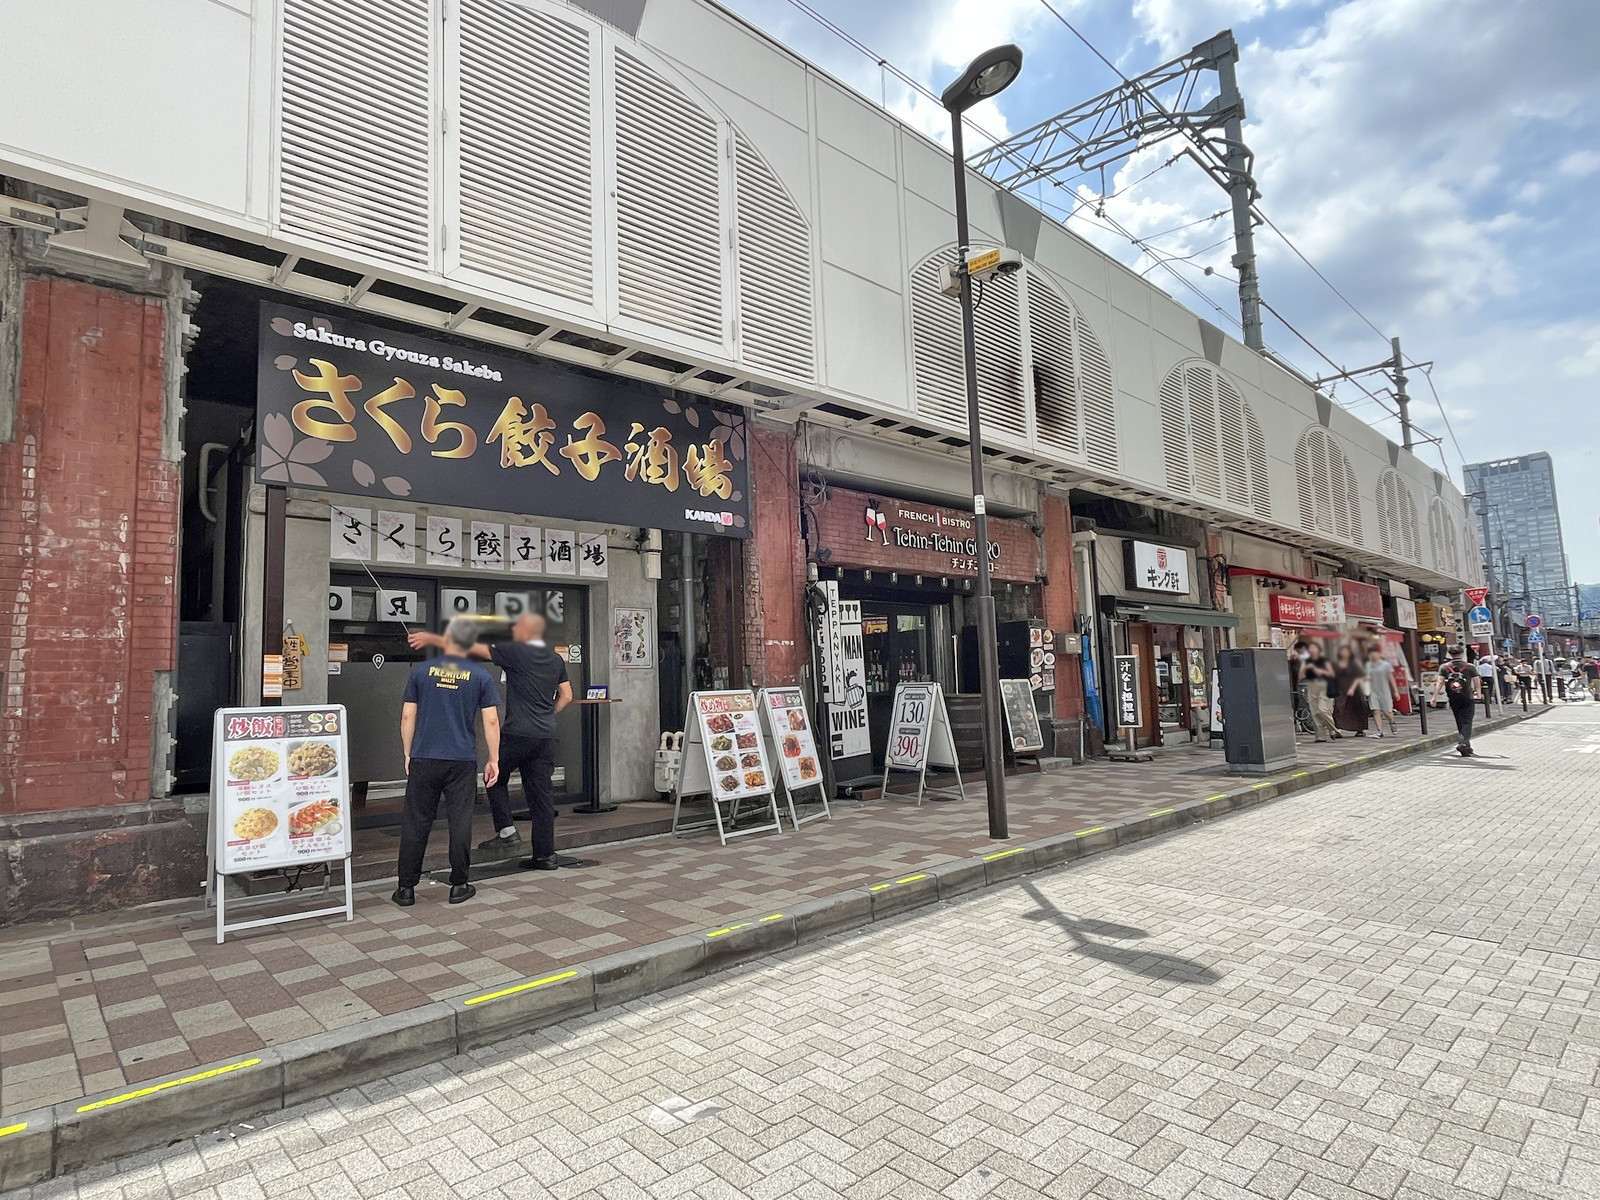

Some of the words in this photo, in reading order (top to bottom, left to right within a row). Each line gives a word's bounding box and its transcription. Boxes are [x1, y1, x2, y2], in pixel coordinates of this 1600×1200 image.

[293, 322, 367, 352] Sakura
[369, 340, 440, 368] Gyouza
[442, 356, 503, 382] Sakeba
[291, 357, 734, 501] さくら餃子酒場
[685, 509, 721, 524] KANDA
[898, 509, 935, 523] FRENCH
[942, 517, 971, 529] BISTRO
[344, 518, 605, 567] さくら餃子酒場
[893, 526, 964, 554] Tchin-Tchin
[966, 538, 1000, 561] GRO
[633, 612, 646, 659] さくら
[829, 588, 842, 694] TEPPANYAKI
[429, 666, 471, 681] PREMIUM
[228, 716, 273, 739] 炒飯
[831, 708, 867, 732] WINE
